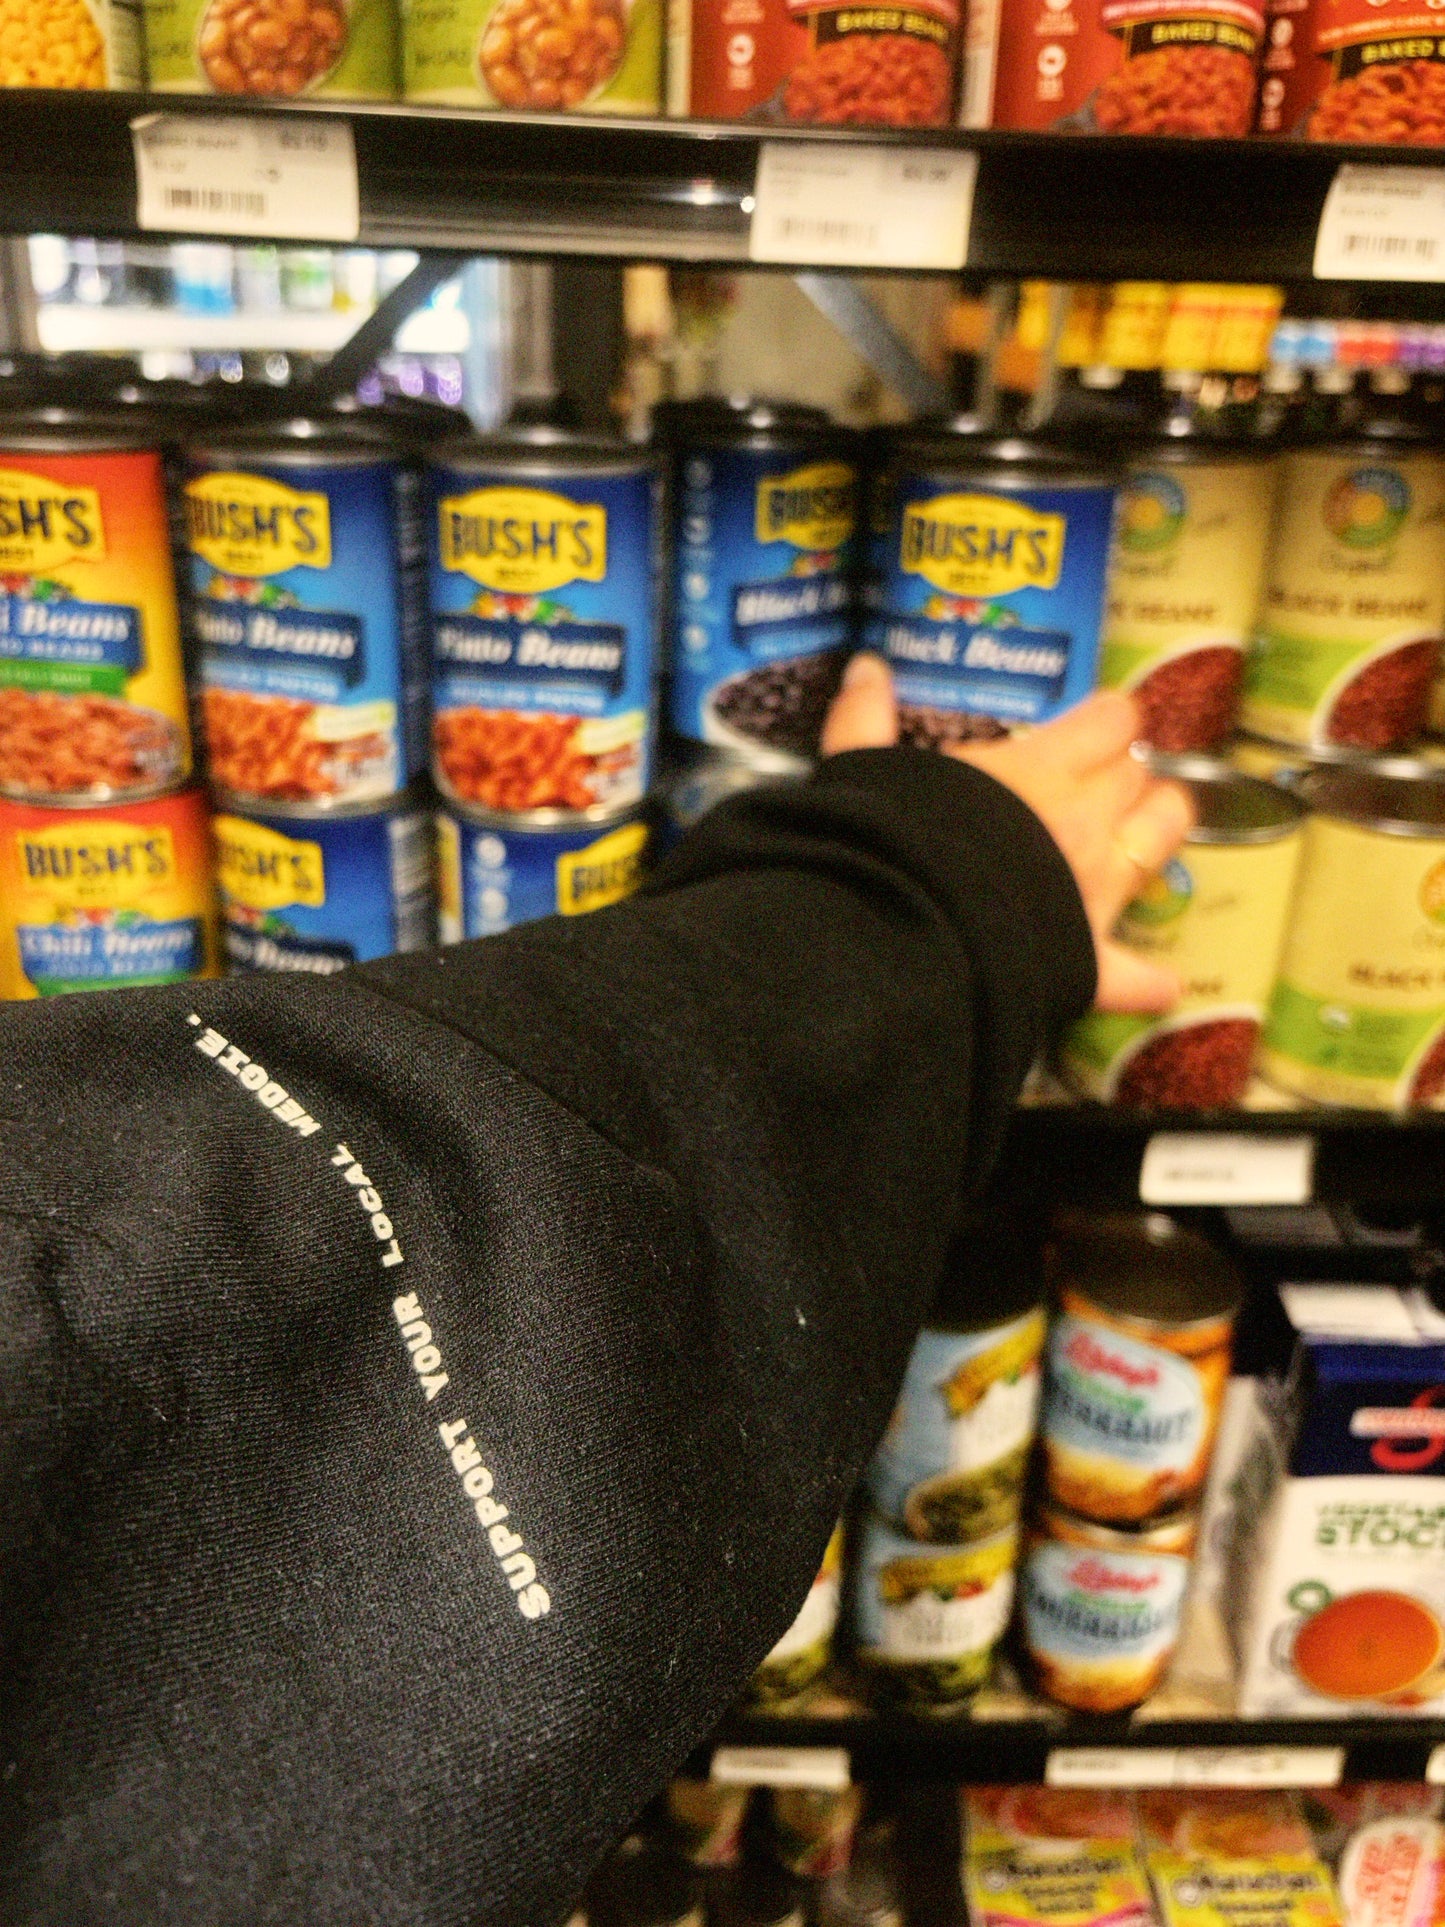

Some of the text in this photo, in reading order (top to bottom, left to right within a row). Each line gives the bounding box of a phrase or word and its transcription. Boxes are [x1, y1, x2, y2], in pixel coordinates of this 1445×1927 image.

[836, 11, 902, 32] BAKED
[1151, 22, 1215, 44] BAKED
[1361, 39, 1434, 64] BAKED
[451, 511, 594, 567] BUSH'S
[907, 515, 1048, 578] BUSH'S
[516, 629, 622, 672] Beans
[25, 838, 168, 880] BUSH'S
[187, 1013, 552, 1621] SUPPORT YOUR LOCAL WEDGIE.
[1316, 1519, 1445, 1547] STOC
